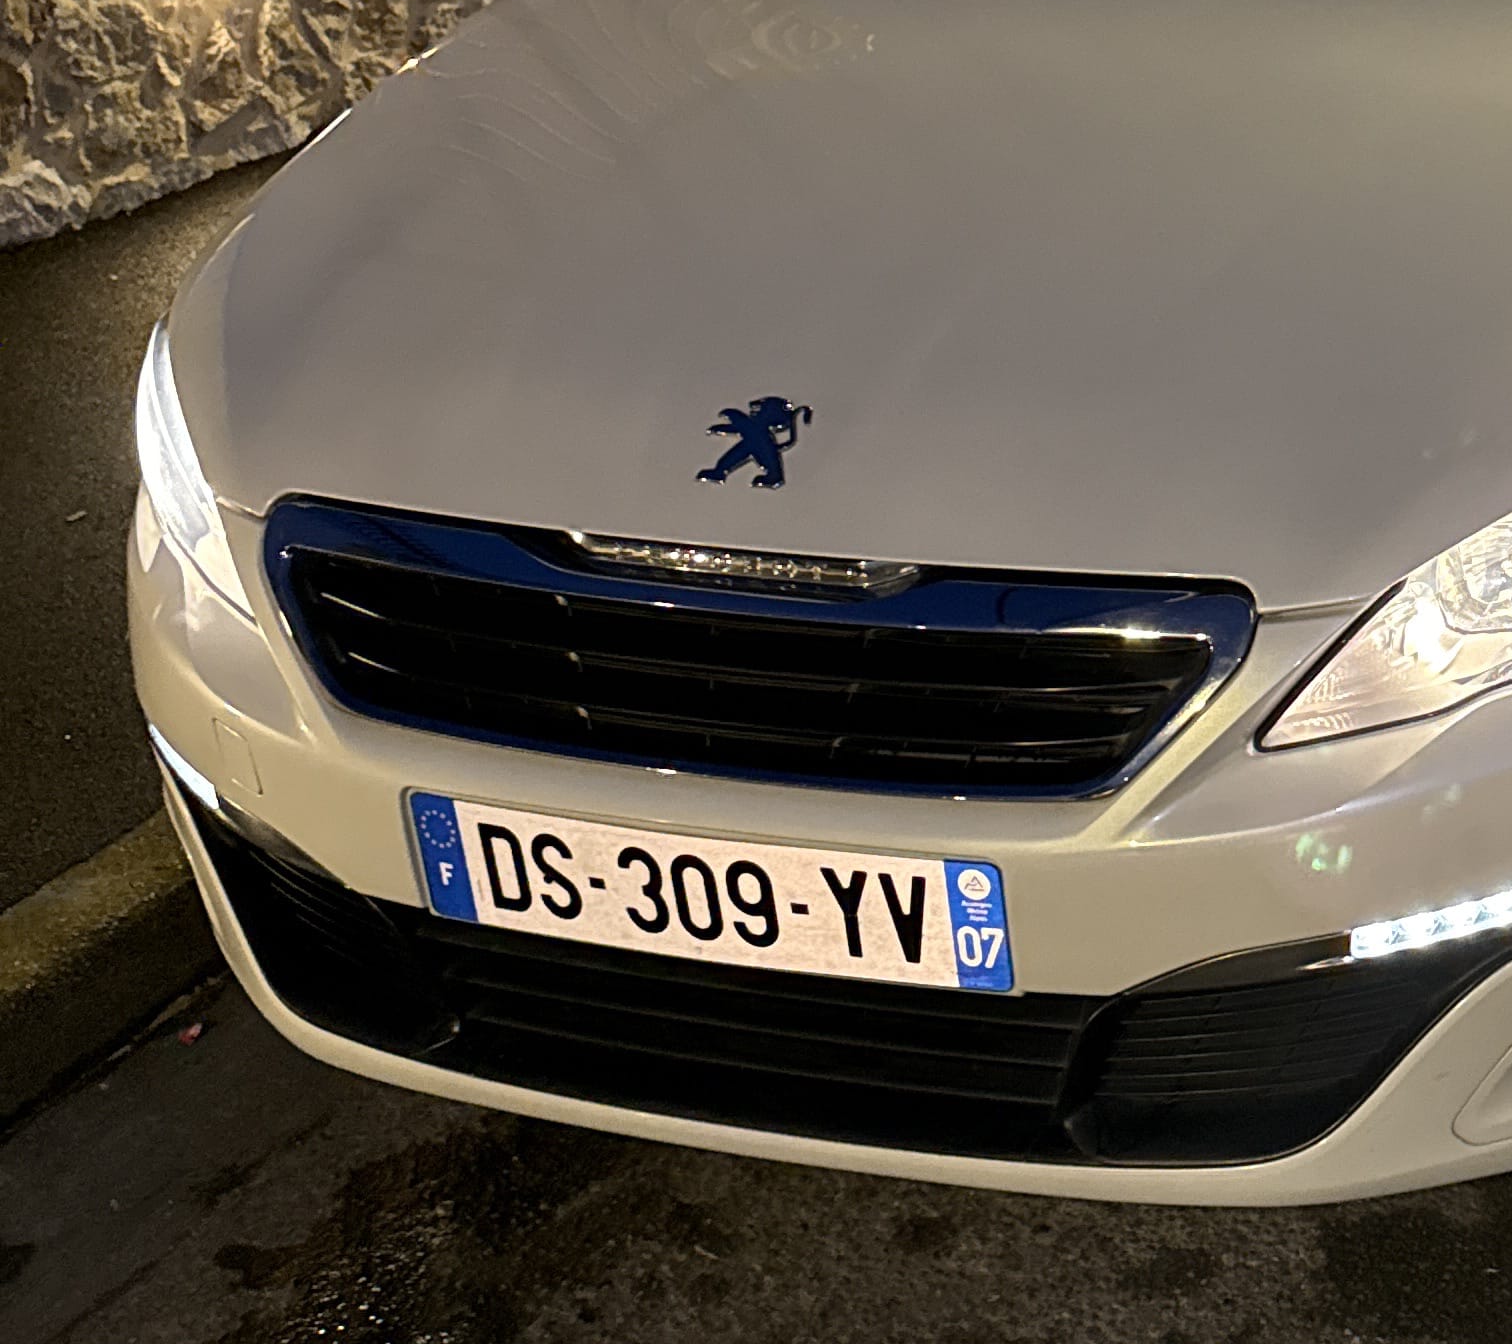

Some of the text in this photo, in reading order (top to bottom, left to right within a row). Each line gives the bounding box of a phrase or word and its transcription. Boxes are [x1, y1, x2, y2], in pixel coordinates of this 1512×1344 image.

[439, 861, 454, 886] F
[477, 821, 927, 965] DS-309-YV
[957, 925, 1005, 969] 07
